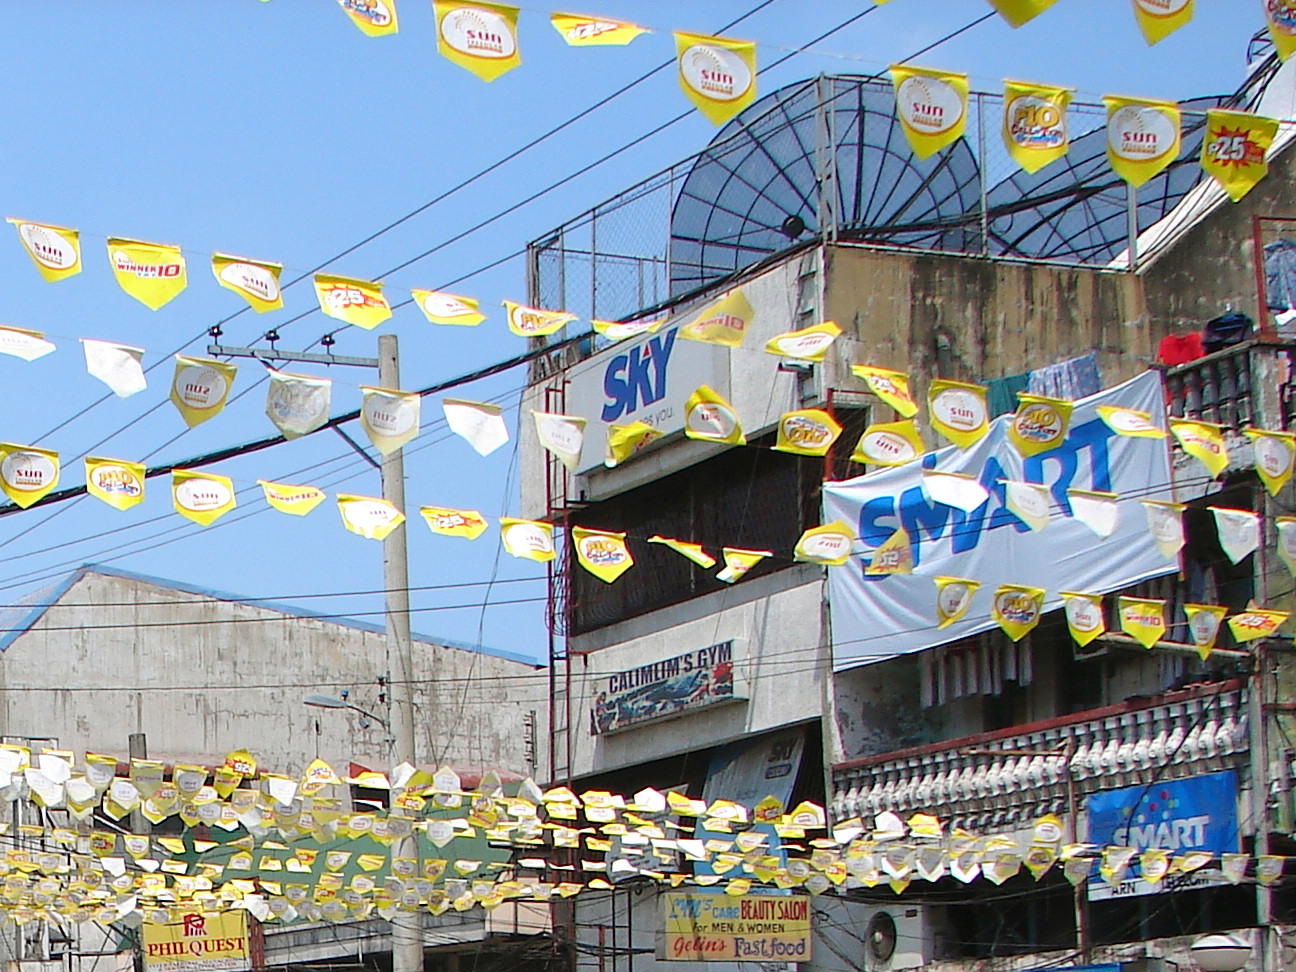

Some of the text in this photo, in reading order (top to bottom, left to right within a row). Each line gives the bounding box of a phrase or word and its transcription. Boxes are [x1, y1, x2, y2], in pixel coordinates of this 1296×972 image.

[466, 29, 502, 44] sun
[701, 69, 733, 85] sun
[912, 102, 943, 117] sun
[1122, 131, 1156, 143] sun
[117, 263, 179, 277] WINNER 10
[601, 325, 679, 423] SKY
[949, 406, 974, 418] sun
[15, 469, 42, 478] sun
[859, 418, 1116, 580] SMART
[608, 640, 732, 694] CALIMLIM'S GYM
[1112, 814, 1211, 850] SMART
[712, 906, 740, 919] CARE
[740, 900, 776, 920] BEAUTY
[777, 900, 808, 920] SALON
[711, 923, 734, 933] MEN
[737, 923, 745, 933] &
[746, 923, 785, 933] WOMEN
[147, 937, 245, 957] PHILQUEST
